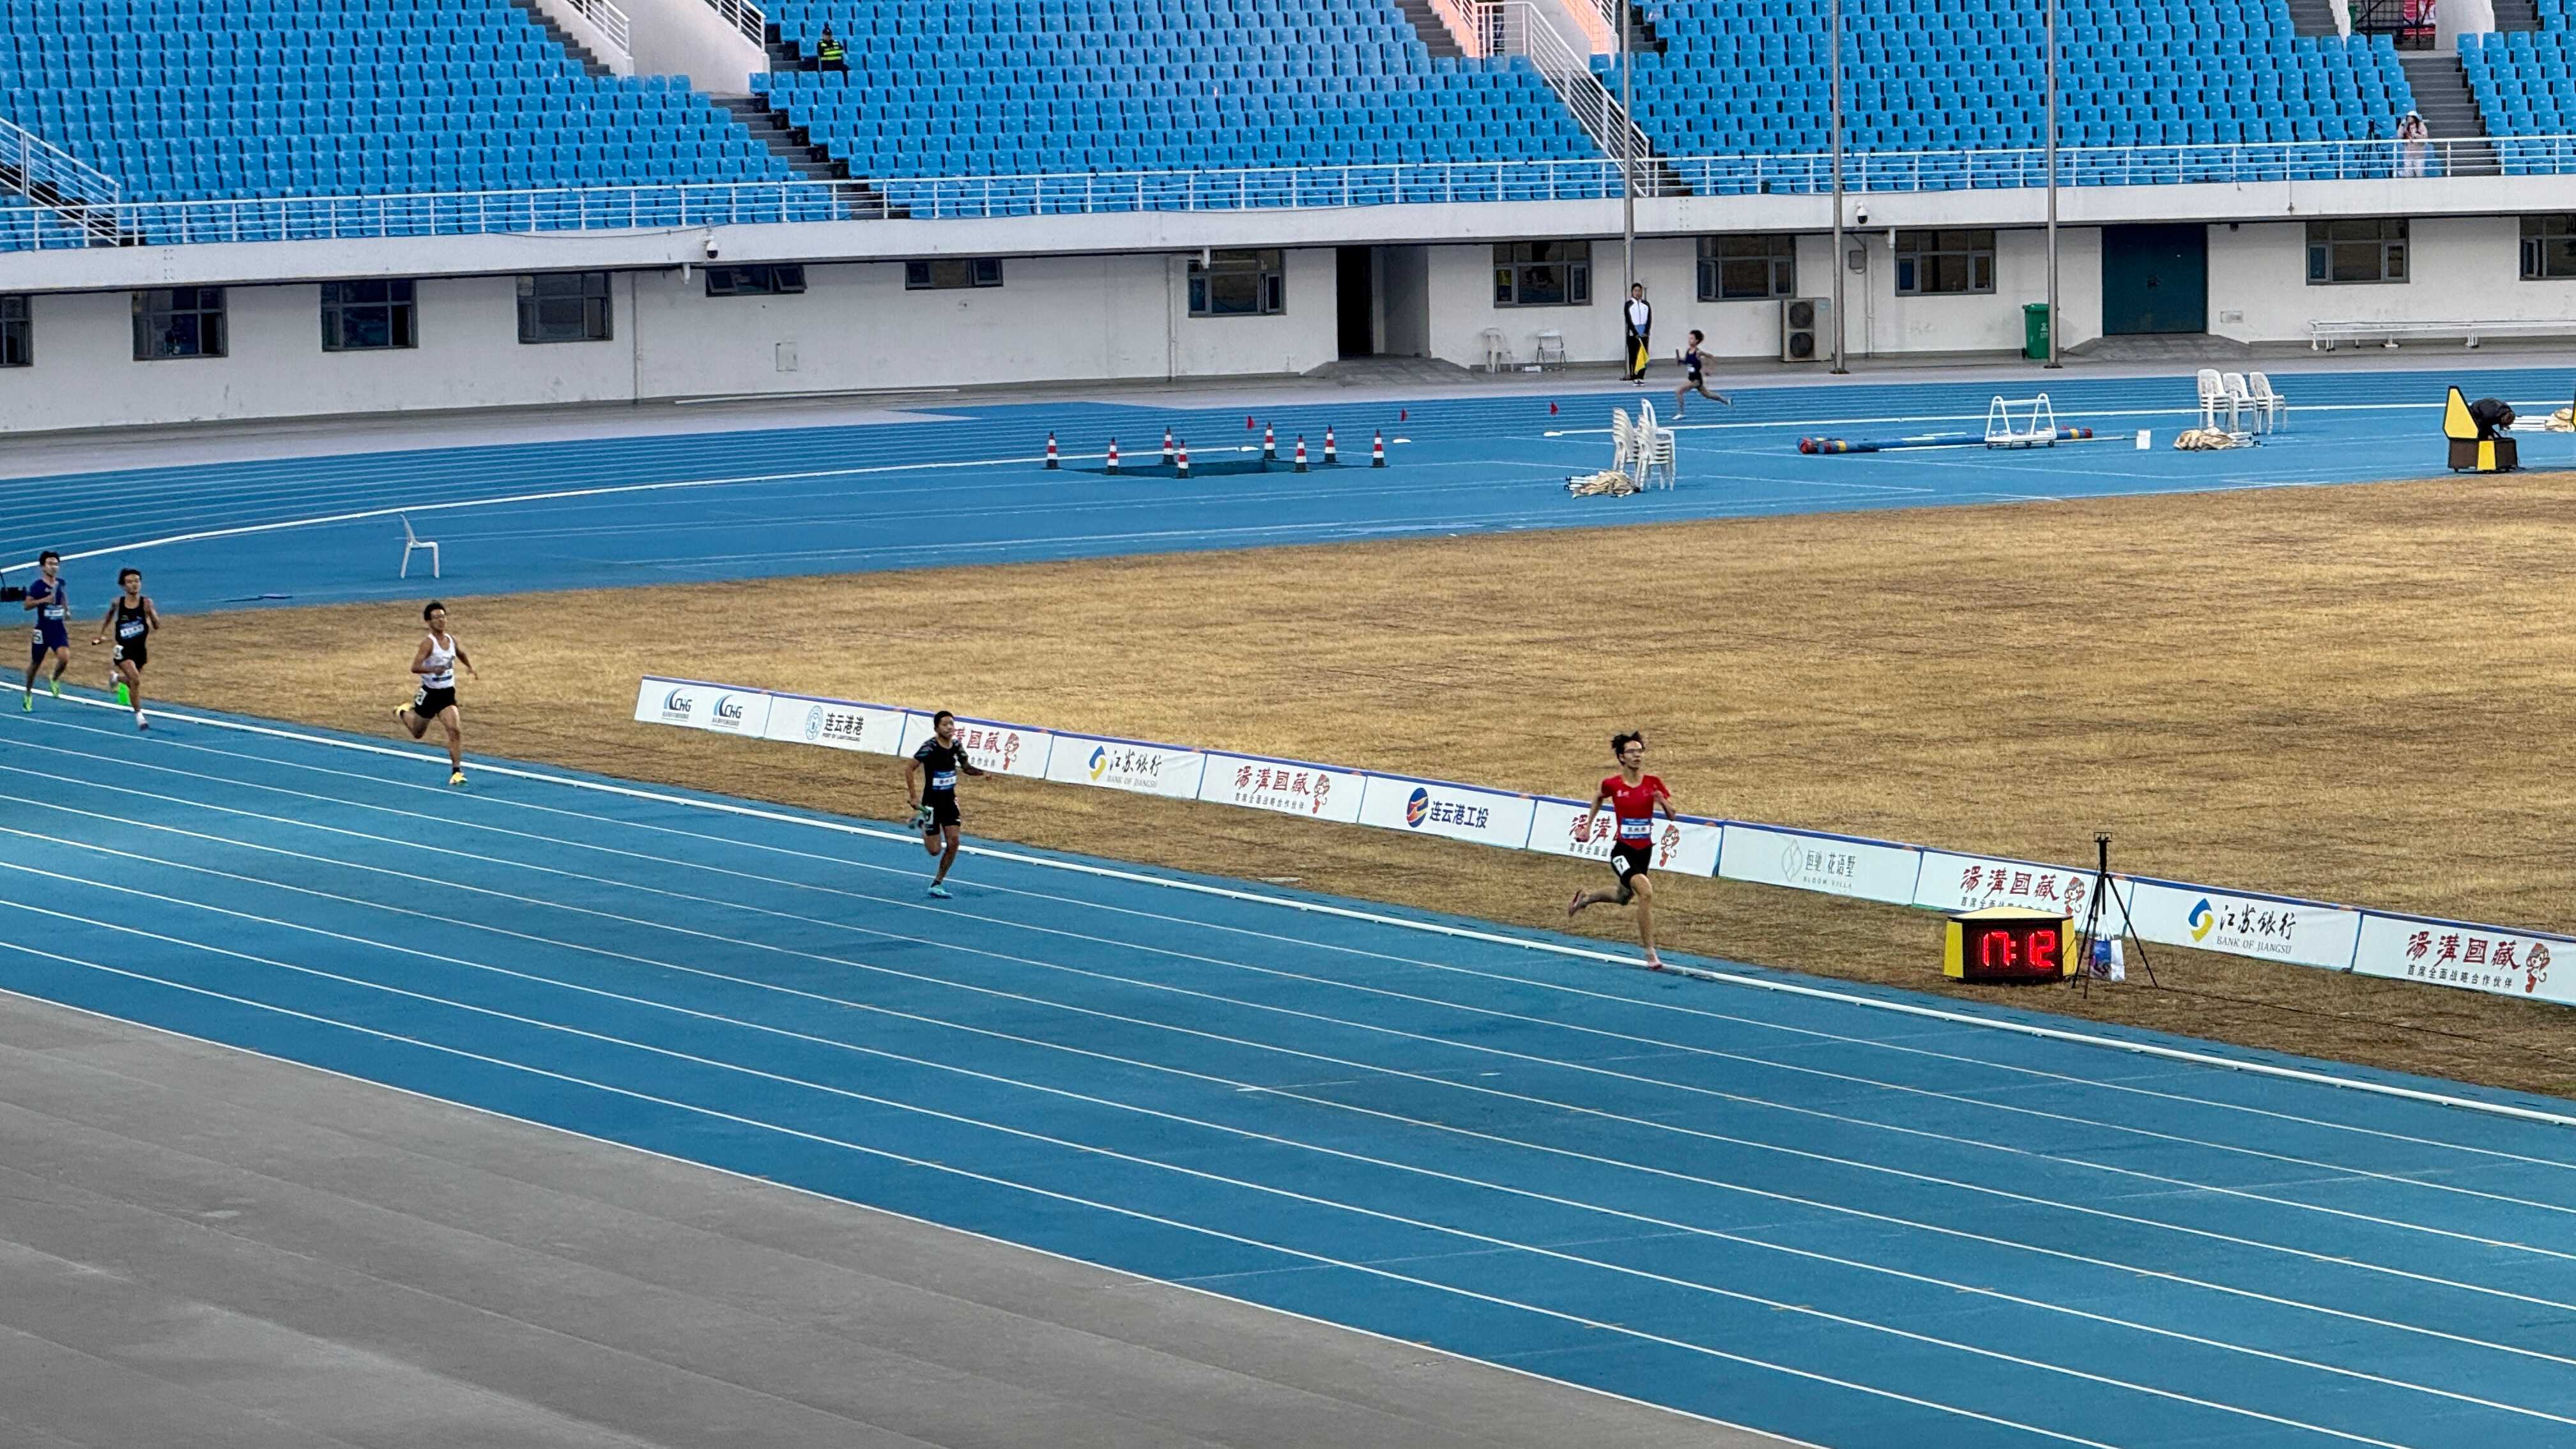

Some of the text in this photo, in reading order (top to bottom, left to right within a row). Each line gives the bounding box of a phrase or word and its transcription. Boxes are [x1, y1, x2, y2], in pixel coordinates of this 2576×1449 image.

[1109, 748, 1162, 778] 江苏银行
[1430, 800, 1489, 829] 连云港工投
[1614, 857, 1623, 870] 7
[1803, 876, 1827, 884] BLOOM
[2219, 903, 2297, 940] 江苏银行
[1982, 930, 2055, 967] 17:12
[2217, 935, 2292, 954] BANK OF JIANGSU
[2407, 964, 2513, 989] 首席全面战略合作伙伴
